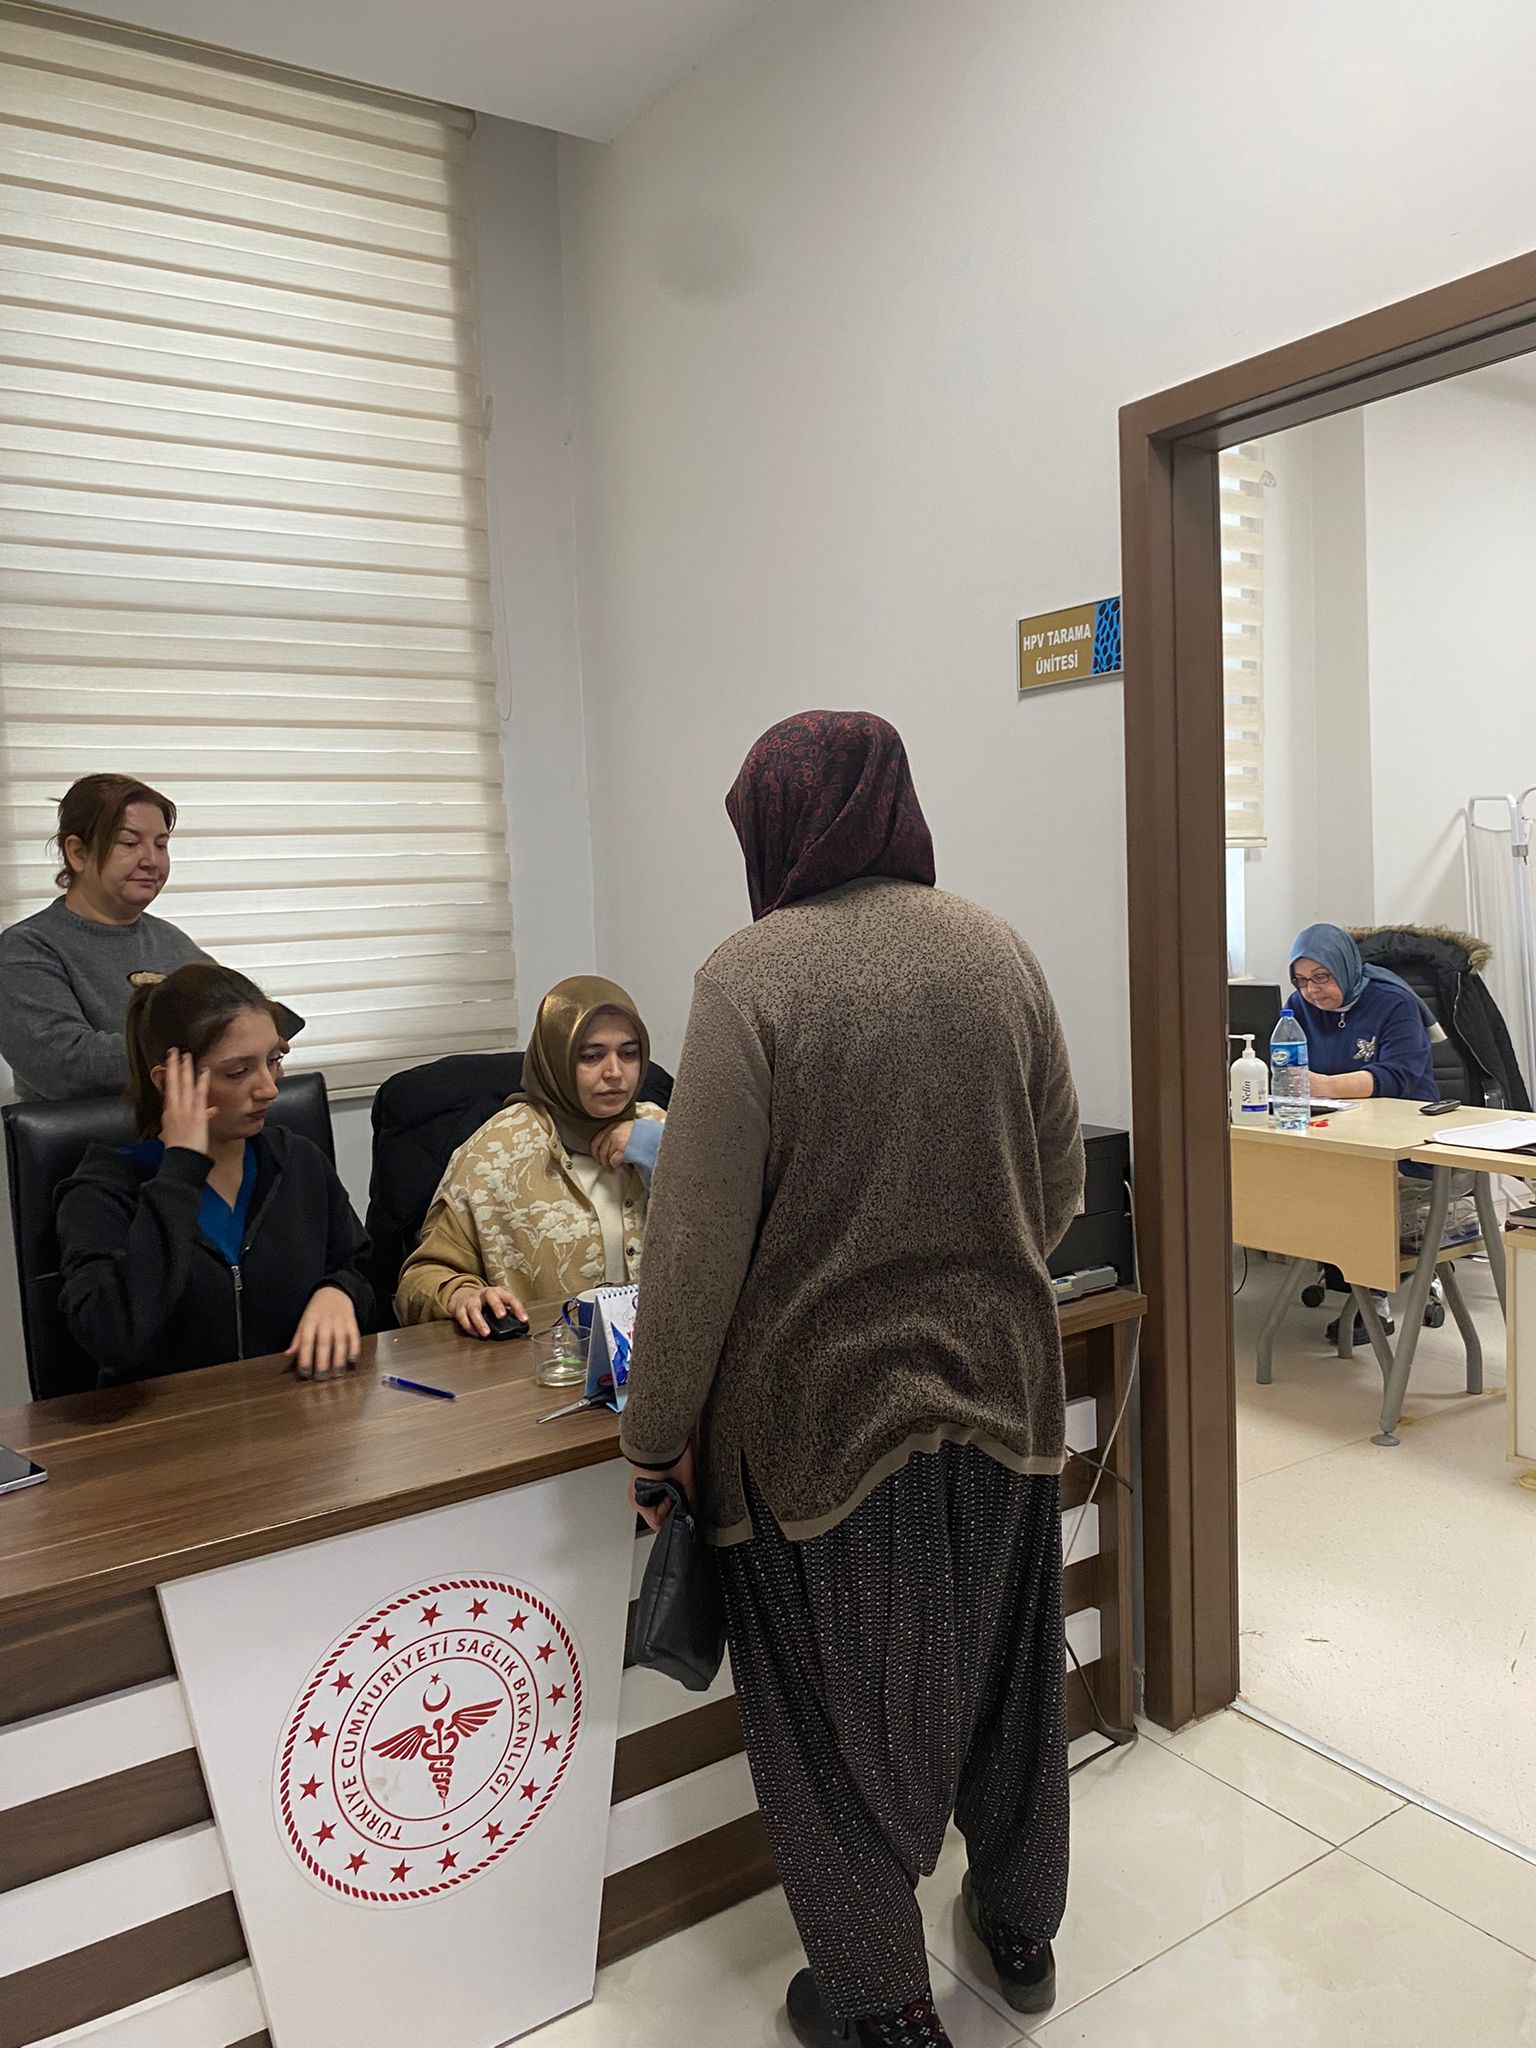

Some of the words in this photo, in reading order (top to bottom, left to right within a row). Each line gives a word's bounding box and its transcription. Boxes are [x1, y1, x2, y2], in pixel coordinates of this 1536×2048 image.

[1023, 633, 1045, 651] HPV
[1047, 624, 1091, 646] TARAMA
[1036, 650, 1078, 675] ÜNİTESİ
[1242, 1080, 1251, 1104] Selin
[456, 1638, 519, 1677] SAĞLIK
[342, 1637, 449, 1768] CUMHURİYETİ
[489, 1678, 531, 1796] BAKANLIĞI
[342, 1776, 403, 1840] TÜRKİYE
